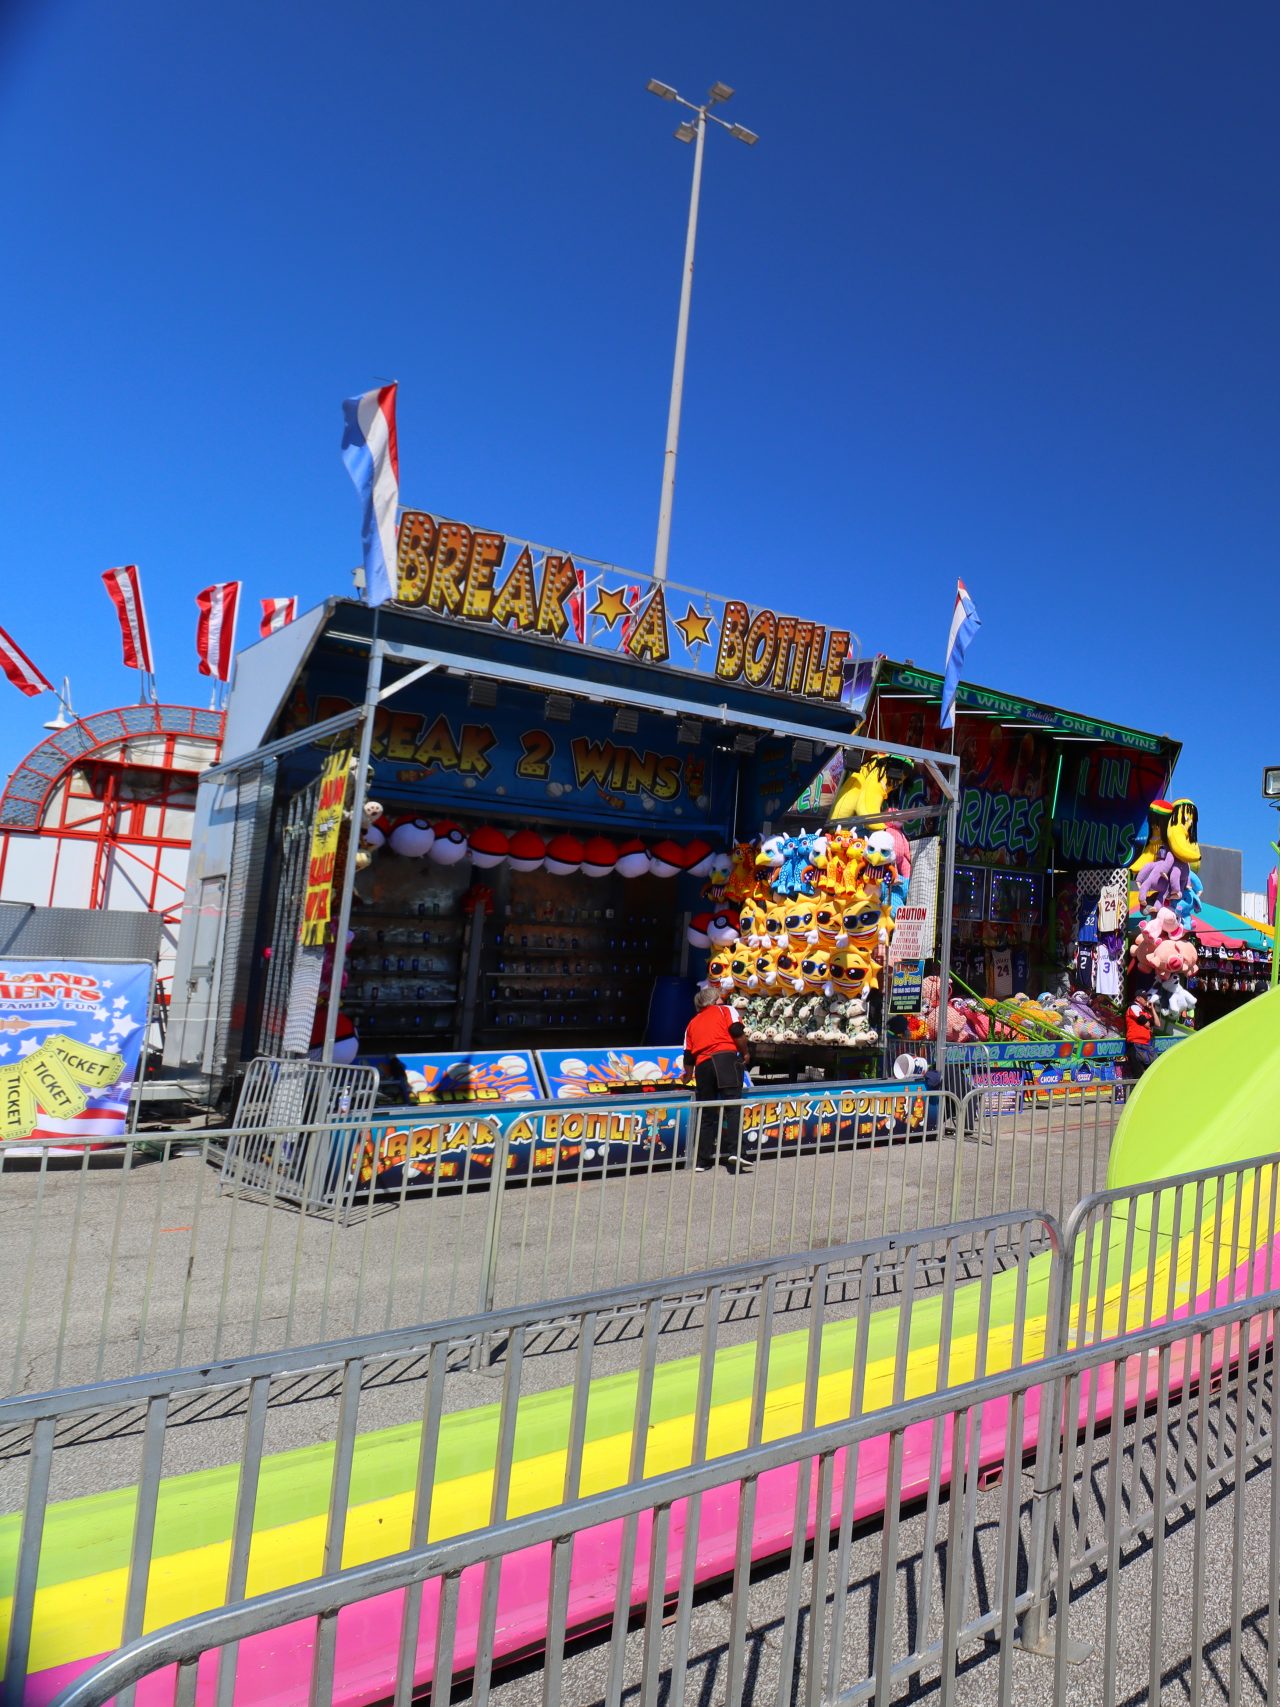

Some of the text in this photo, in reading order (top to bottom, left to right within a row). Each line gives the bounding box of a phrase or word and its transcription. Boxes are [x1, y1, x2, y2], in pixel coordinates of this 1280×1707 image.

[397, 511, 849, 702] BREAK A BOTTLE
[898, 674, 940, 692] ONE
[976, 694, 1022, 714] WINS
[1062, 718, 1095, 734] ONE
[1101, 729, 1116, 740] IN
[1121, 734, 1158, 751] WINS
[516, 729, 555, 781] 2
[571, 736, 684, 802] WINS
[1099, 758, 1131, 799] IN
[938, 785, 1044, 853] RIZES
[1062, 819, 1136, 865] WINS
[896, 907, 927, 920] CAUTION
[1104, 900, 1116, 912] 24
[1080, 956, 1087, 969] 2
[1103, 962, 1111, 974] 3
[66, 1002, 98, 1011] FUN
[56, 1047, 109, 1077] TICKET
[1004, 1045, 1056, 1058] PRIZES
[1097, 1042, 1123, 1055] WIN
[33, 1061, 72, 1107] TICKET
[1040, 1076, 1060, 1084] CHOICE
[7, 1076, 21, 1126] TICKET
[817, 1096, 835, 1115] A
[511, 1113, 535, 1141] A
[544, 1112, 641, 1142] BOTTLE
